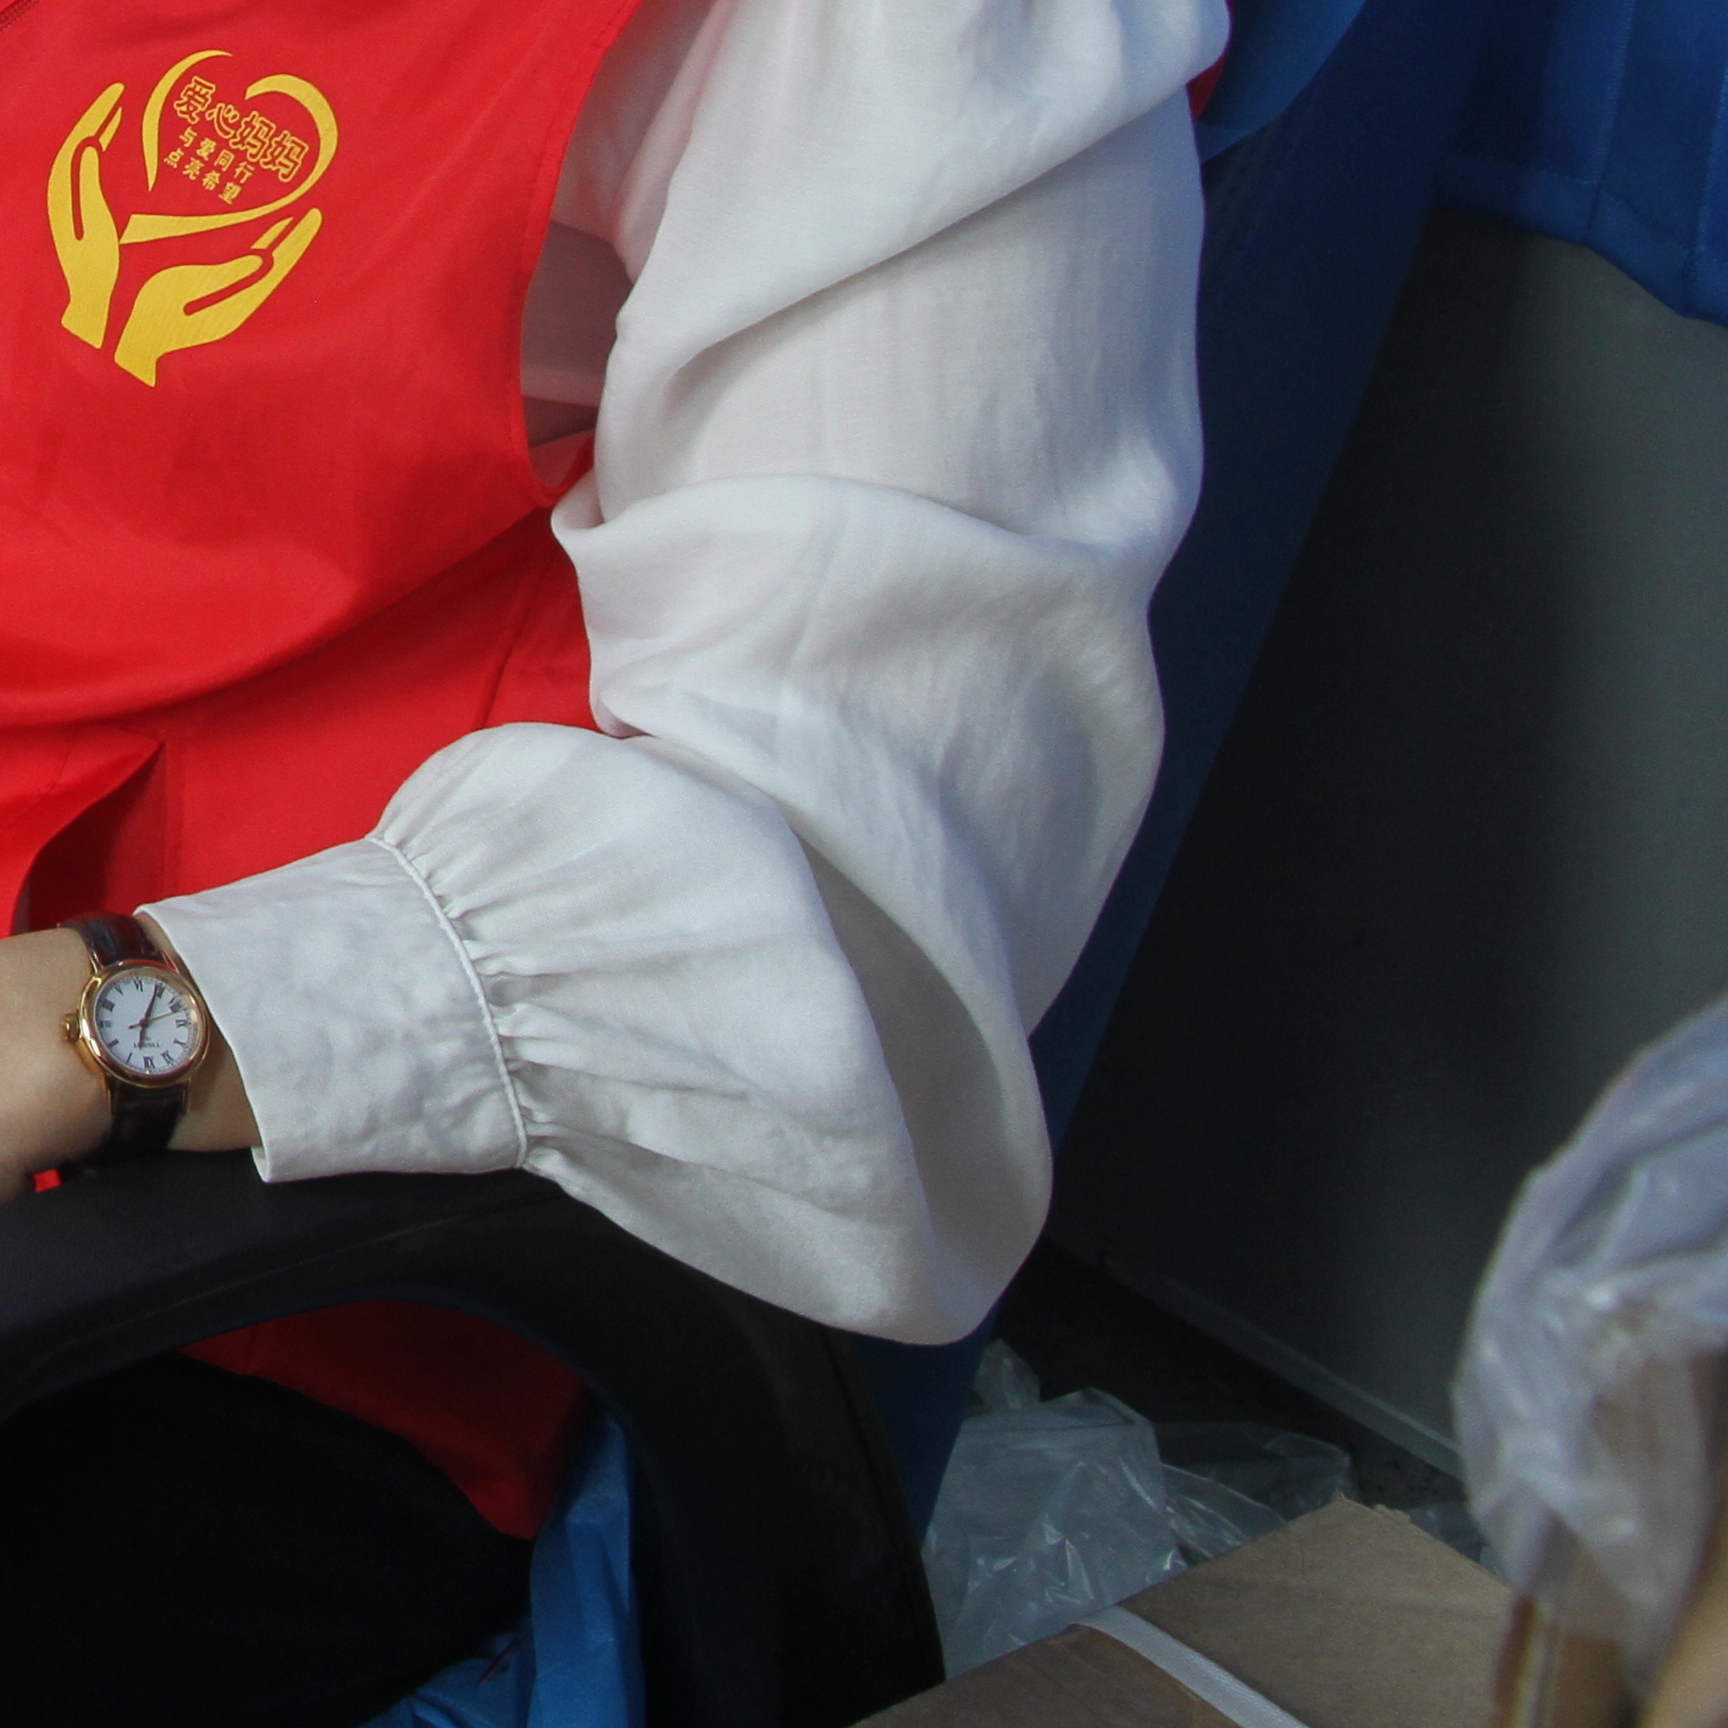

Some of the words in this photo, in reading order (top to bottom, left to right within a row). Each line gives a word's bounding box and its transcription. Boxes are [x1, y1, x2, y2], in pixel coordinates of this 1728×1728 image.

[173, 75, 310, 184] 爱心妈妈
[179, 127, 255, 184] 与爱同行
[163, 147, 243, 205] 点亮希望
